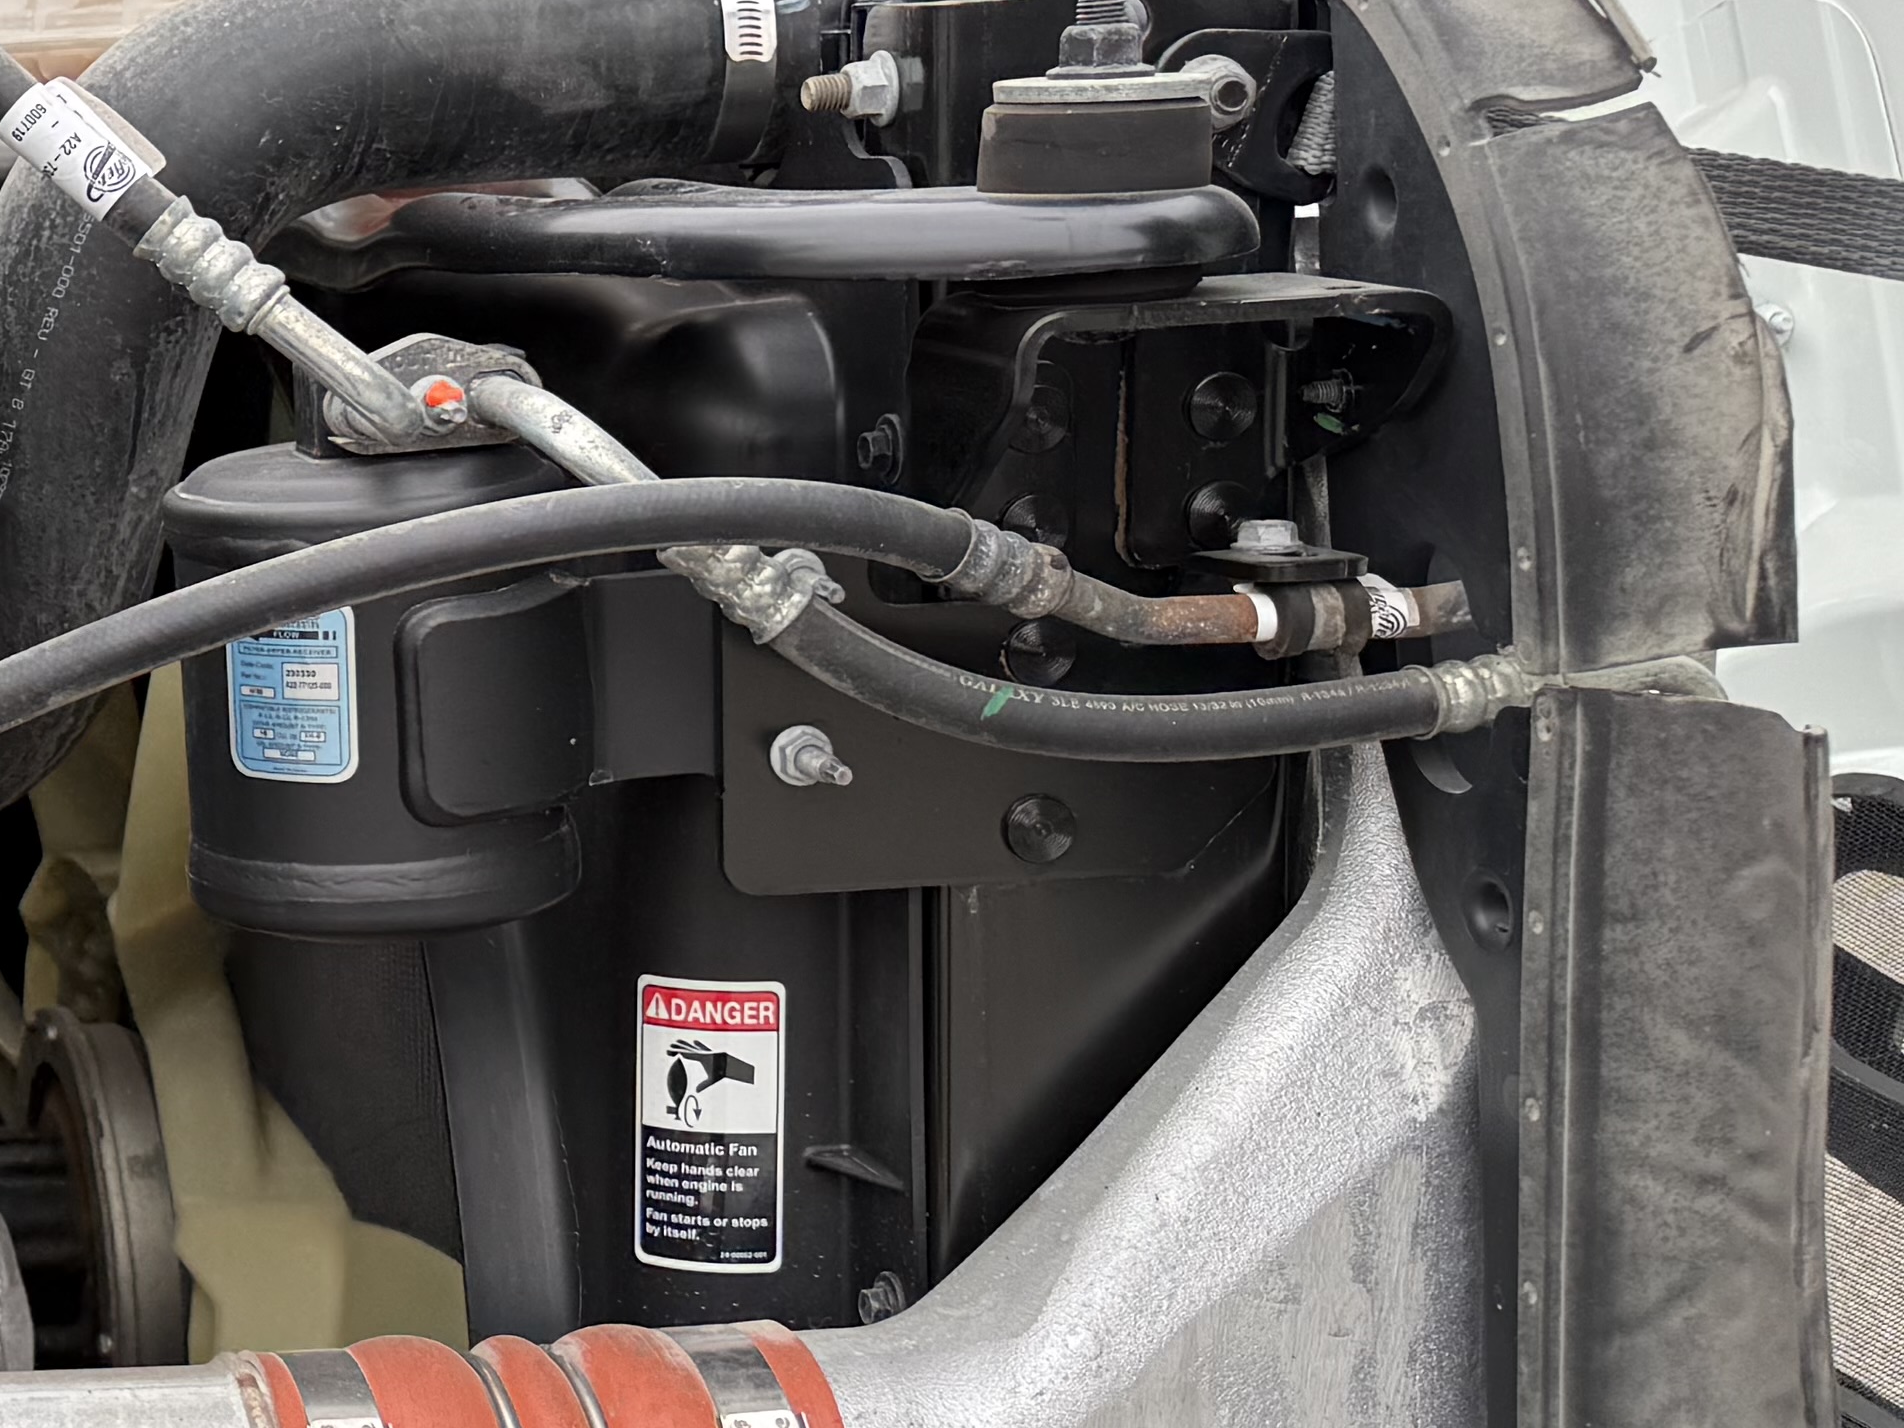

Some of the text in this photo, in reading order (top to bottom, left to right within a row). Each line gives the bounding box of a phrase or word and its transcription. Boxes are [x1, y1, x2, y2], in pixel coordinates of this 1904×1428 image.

[273, 630, 300, 640] FLOW
[1149, 701, 1190, 712] HOSE
[670, 1001, 775, 1024] DANGER
[646, 1136, 757, 1157] Automatic Fan
[646, 1158, 759, 1178] Keep hands clear
[646, 1174, 743, 1195] when engine is
[646, 1191, 698, 1207] running.
[646, 1208, 768, 1230] Fan starts or stops
[646, 1222, 699, 1241] by itself.
